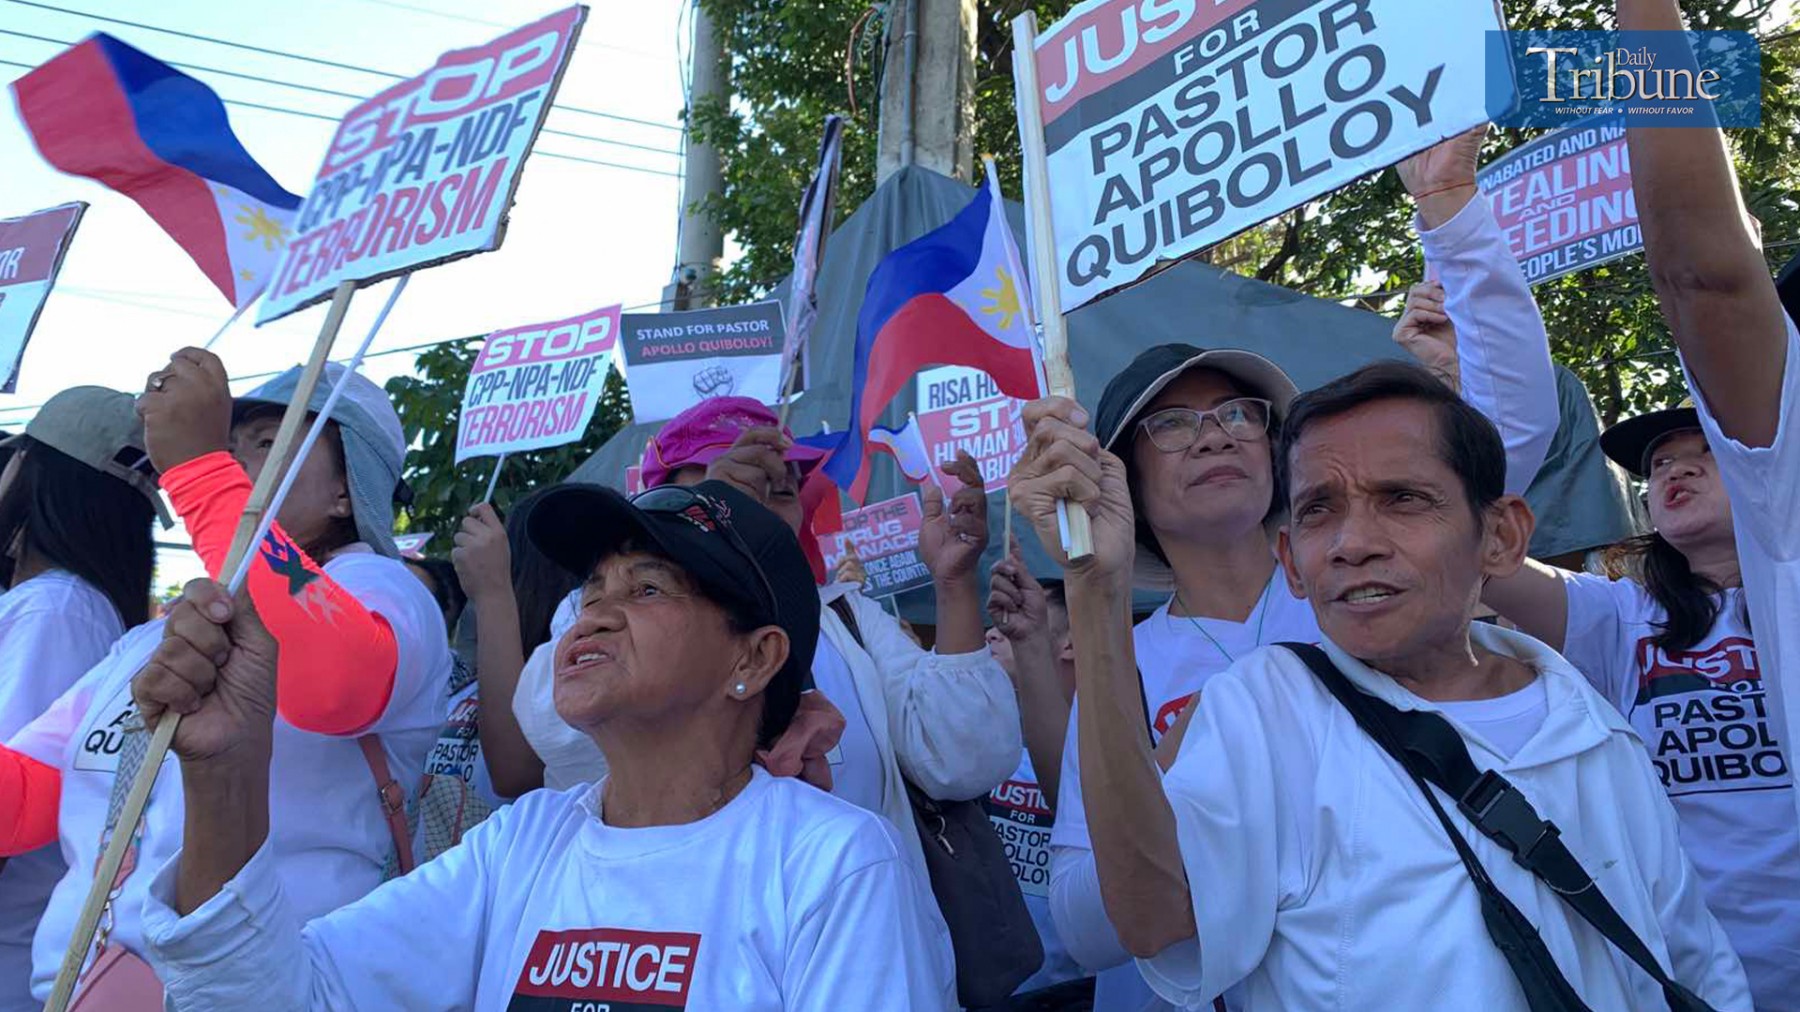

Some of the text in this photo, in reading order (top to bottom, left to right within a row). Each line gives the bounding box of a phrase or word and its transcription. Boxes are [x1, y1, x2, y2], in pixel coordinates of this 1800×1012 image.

[1045, 0, 1228, 103] JUS
[1173, 8, 1261, 76] FOR
[1090, 0, 1377, 175] PASTOR
[1094, 44, 1387, 226] APOLLO
[1558, 129, 1598, 159] AND
[1066, 63, 1446, 288] QUIBOLOY
[1517, 193, 1577, 222] AND
[484, 315, 612, 368] STOP
[636, 319, 770, 340] STAND FOR PASTOR
[641, 336, 773, 358] APOLLO QUIBOLOY!
[467, 355, 603, 408] CPP-NPA-NDF
[928, 376, 972, 410] RISA
[462, 391, 589, 449] TERRORISM
[1009, 809, 1036, 824] FOR
[528, 941, 691, 993] JUSTICE
